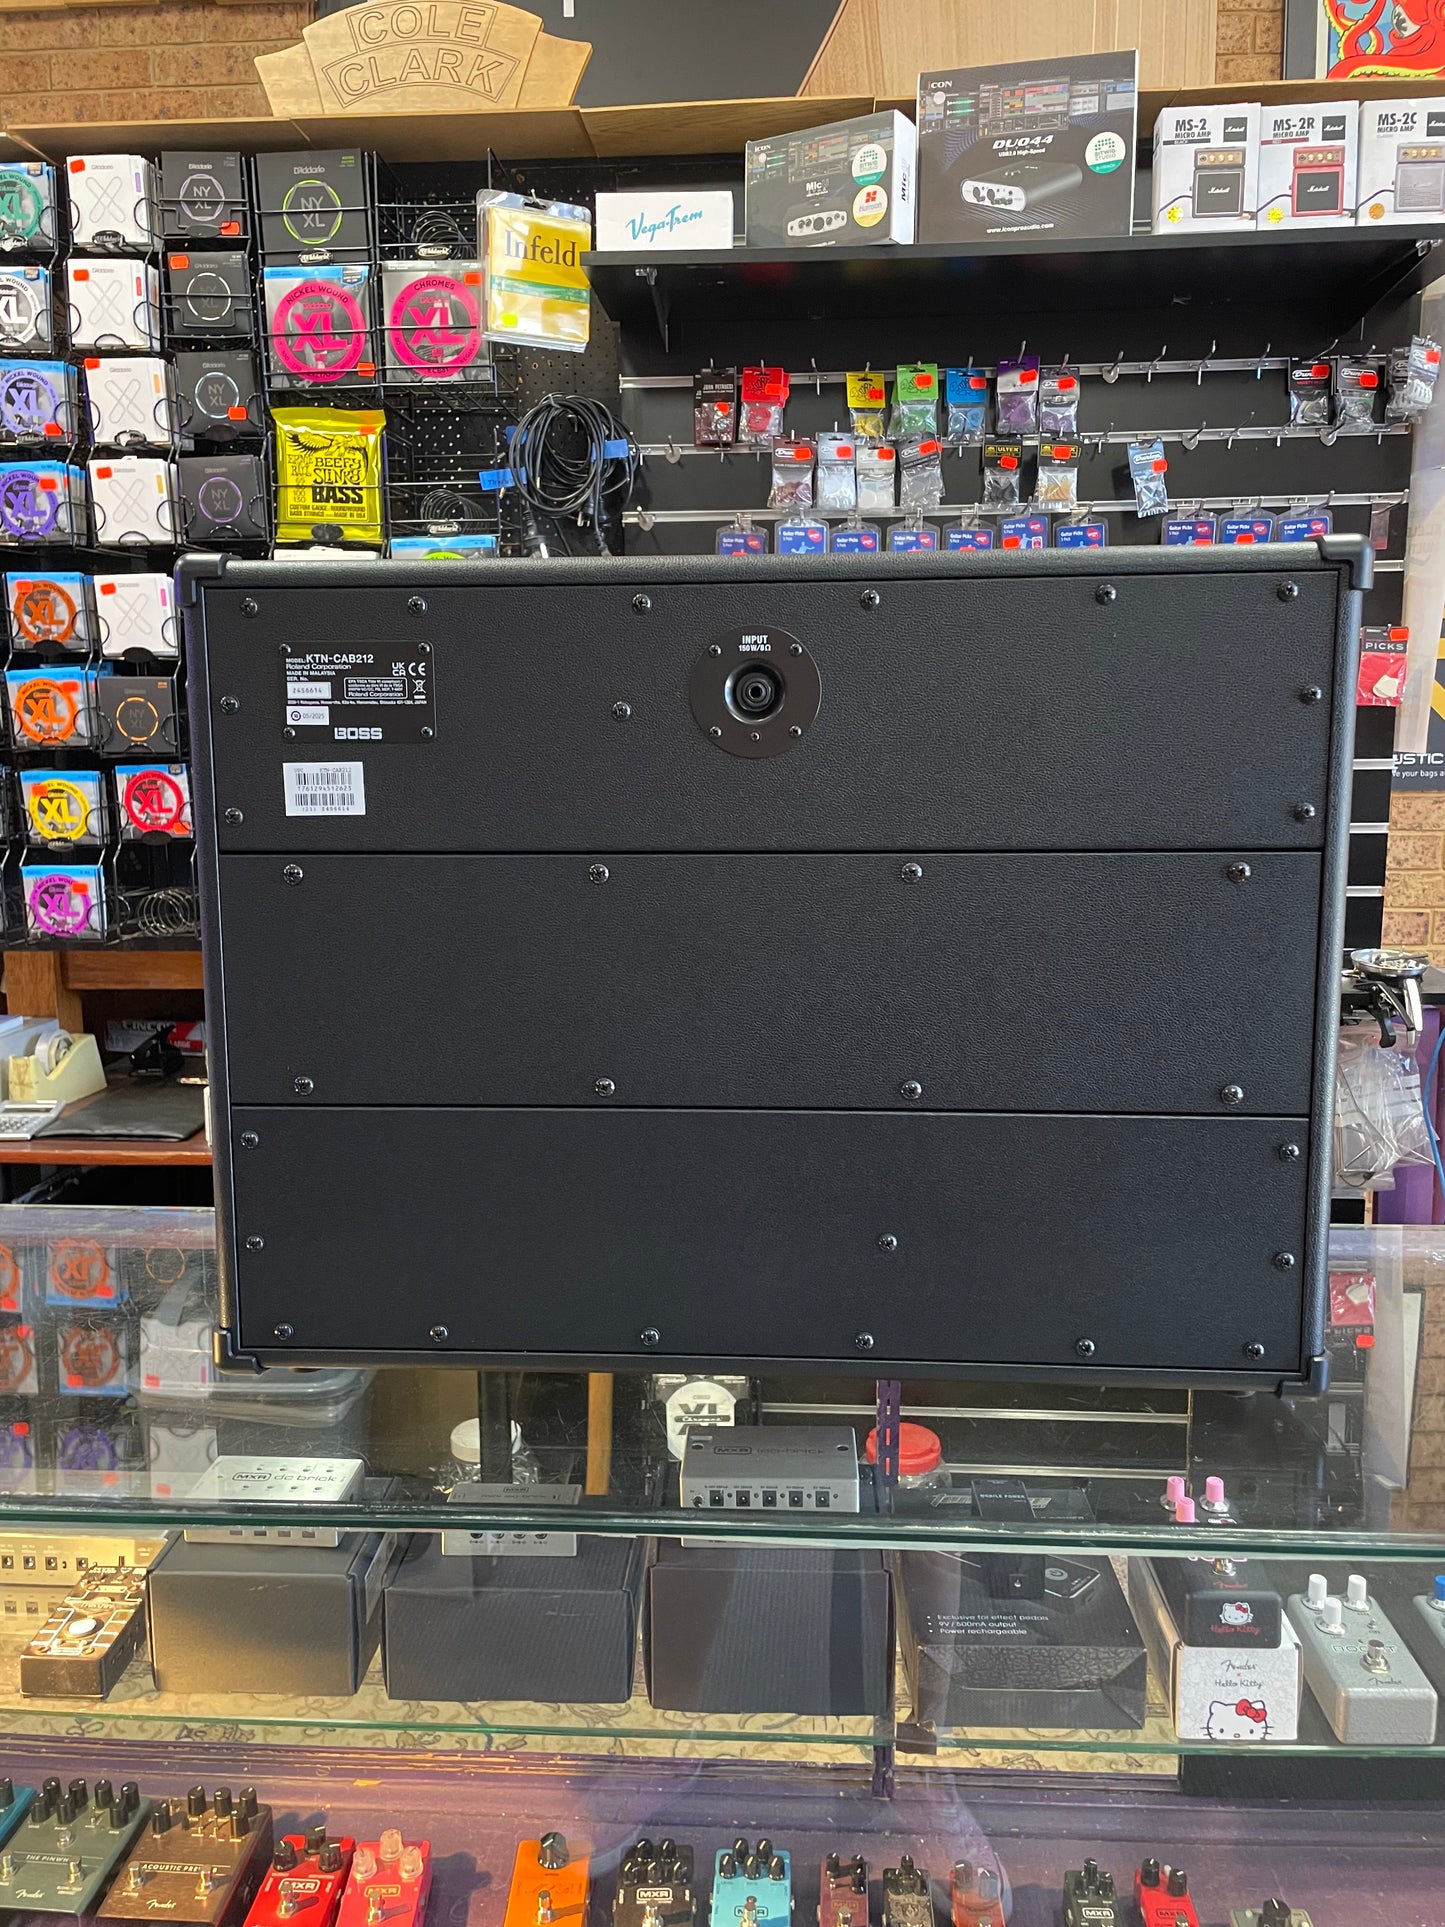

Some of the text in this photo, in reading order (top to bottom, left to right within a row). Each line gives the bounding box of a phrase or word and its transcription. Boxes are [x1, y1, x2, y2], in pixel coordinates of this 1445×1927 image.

[358, 4, 487, 44] COLE
[338, 48, 504, 96] CLARK
[1273, 117, 1315, 131] MS-2R
[1378, 112, 1417, 126] MS-2C
[1175, 119, 1207, 132] MS-2
[1377, 125, 1399, 134] MICRO
[1174, 130, 1212, 139] MICRO AMP
[1272, 129, 1310, 138] MICRO AMP
[992, 134, 1054, 150] DUO44
[193, 186, 211, 197] NY
[300, 196, 324, 210] NY
[303, 213, 326, 228] XL
[503, 229, 577, 268] Infeld
[414, 279, 455, 291] CHROMES
[286, 286, 349, 305] NICKEL WOUND
[291, 311, 348, 352] XL
[407, 306, 465, 346] XL
[27, 371, 49, 386] WOUND
[207, 384, 225, 395] NY
[9, 387, 46, 417] XL
[209, 396, 227, 406] XL
[315, 457, 362, 469] BEEFY
[21, 473, 40, 483] WOUN
[313, 468, 361, 485] SLINKY
[211, 488, 228, 499] NY
[312, 486, 363, 504] BASS
[6, 491, 47, 518] XL
[213, 500, 231, 511] XL
[25, 600, 65, 626] XL
[742, 635, 769, 644] INPUT
[1365, 641, 1405, 651] PICKS
[306, 653, 374, 664] KTN-CAB212
[25, 698, 66, 724] XL
[334, 727, 383, 740] BOSS
[1402, 770, 1419, 779] your
[1420, 770, 1439, 779] bags
[135, 789, 174, 814] XL
[40, 798, 79, 823] XL
[41, 893, 80, 917] XL
[236, 1473, 267, 1481] MXR
[297, 1473, 337, 1482] brick
[1019, 1614, 1049, 1622] pedals
[988, 1621, 1017, 1629] output
[1210, 1624, 1261, 1635] Hello Kitty
[940, 1628, 1028, 1636] Power rechargeable
[1220, 1659, 1258, 1671] Fender
[1214, 1679, 1264, 1690] Hello Kitty
[142, 1863, 182, 1872] ACOUSTIC
[15, 1888, 45, 1899] Fender
[640, 1890, 669, 1899] MXR
[146, 1899, 177, 1910] Fender
[1085, 1909, 1111, 1917] MXR
